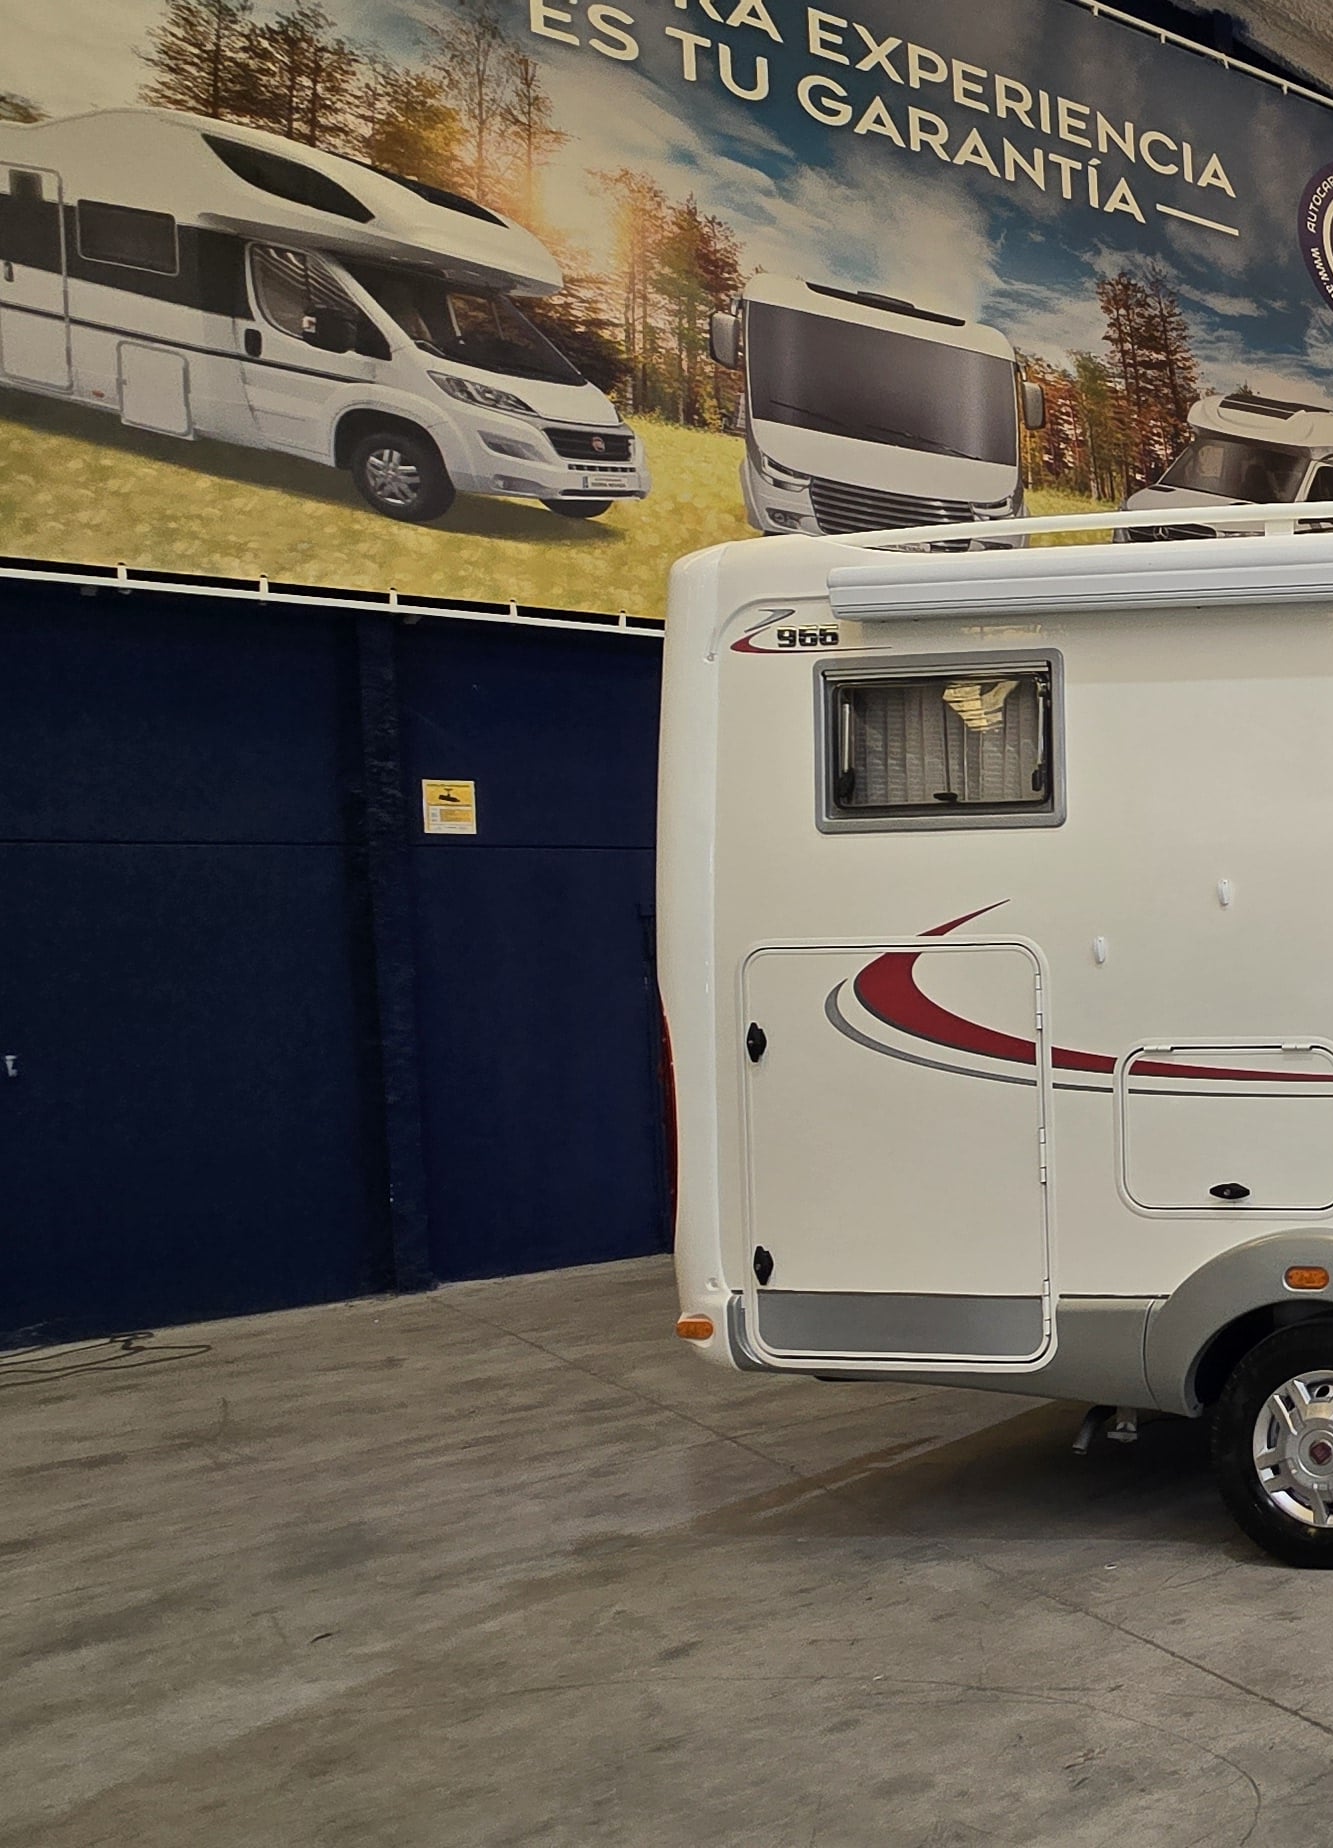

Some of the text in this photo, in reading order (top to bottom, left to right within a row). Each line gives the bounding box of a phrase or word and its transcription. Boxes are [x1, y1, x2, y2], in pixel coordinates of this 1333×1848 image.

[530, 0, 1146, 224] ES TU GARANTÍA
[807, 7, 1237, 199] EXPERIENCIA
[777, 624, 839, 648] 966
